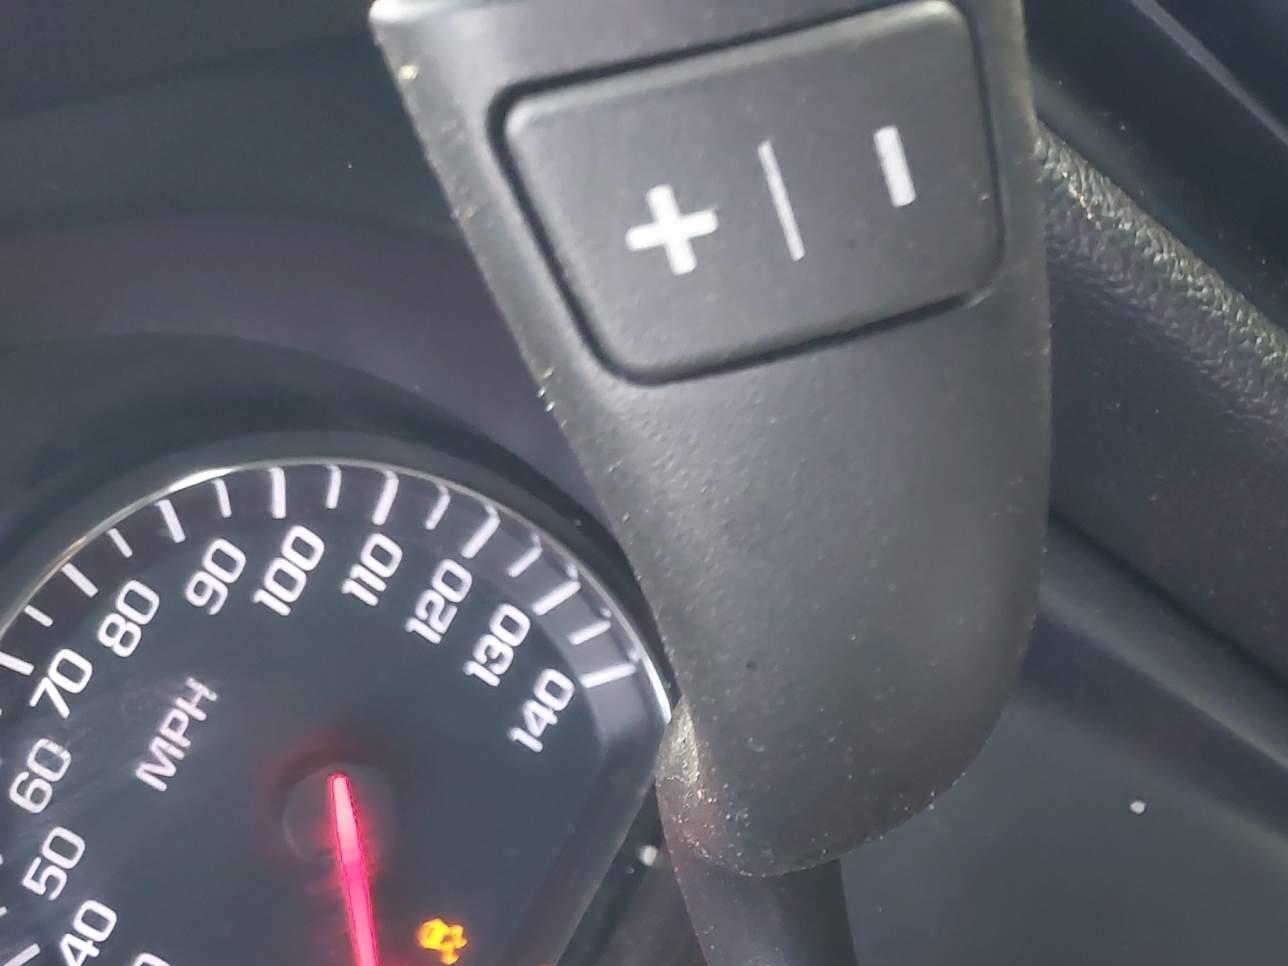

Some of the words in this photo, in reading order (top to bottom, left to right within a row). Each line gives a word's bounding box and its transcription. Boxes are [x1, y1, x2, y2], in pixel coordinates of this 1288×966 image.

[185, 538, 247, 615] 90
[254, 525, 325, 616] 100
[341, 533, 403, 606] 110
[406, 558, 473, 644] 120
[97, 580, 160, 658] 80
[465, 603, 532, 687] 130
[29, 648, 93, 719] 70
[510, 668, 575, 752] 140
[135, 677, 218, 792] MPH
[9, 738, 72, 814] 60
[21, 826, 86, 901] 50
